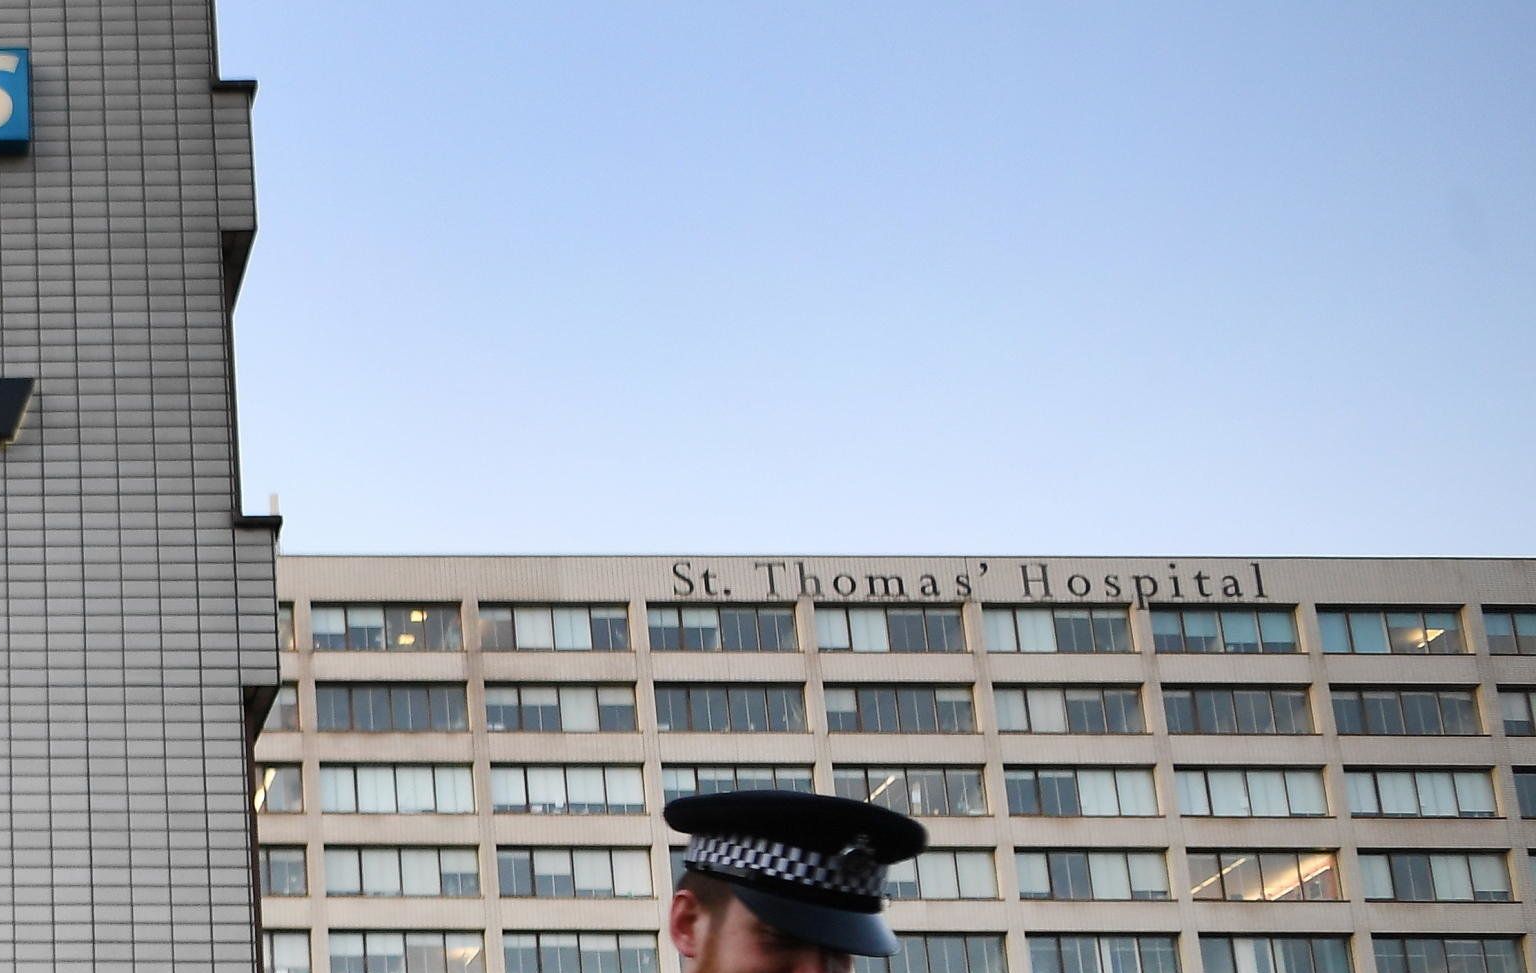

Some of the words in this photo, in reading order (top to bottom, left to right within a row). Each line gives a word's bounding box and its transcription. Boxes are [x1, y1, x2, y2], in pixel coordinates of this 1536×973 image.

[672, 561, 732, 597] St.
[754, 561, 989, 600] Thomas'
[1020, 562, 1269, 610] Hospital
